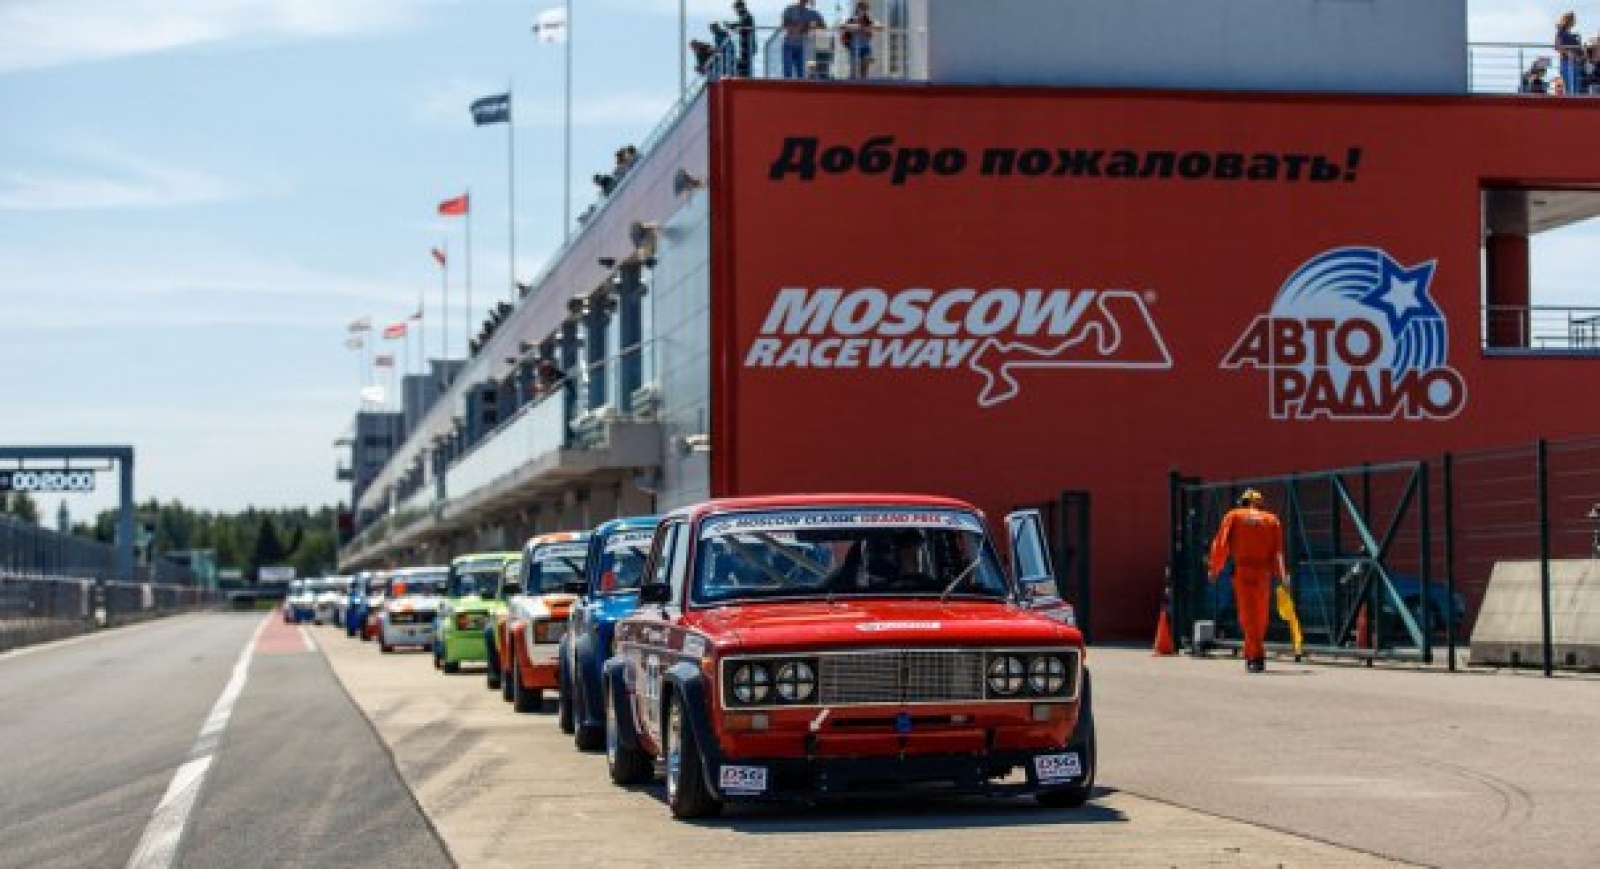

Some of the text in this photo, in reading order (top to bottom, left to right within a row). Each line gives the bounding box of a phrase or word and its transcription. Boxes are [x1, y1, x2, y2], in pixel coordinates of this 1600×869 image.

[769, 136, 1362, 184] Добро пожаловать!
[761, 288, 1098, 336] MOSCOW
[744, 338, 974, 367] RACEWAY
[1221, 316, 1383, 367] АВТО
[1272, 368, 1466, 418] РАДИО
[736, 516, 800, 528] MOSCOW
